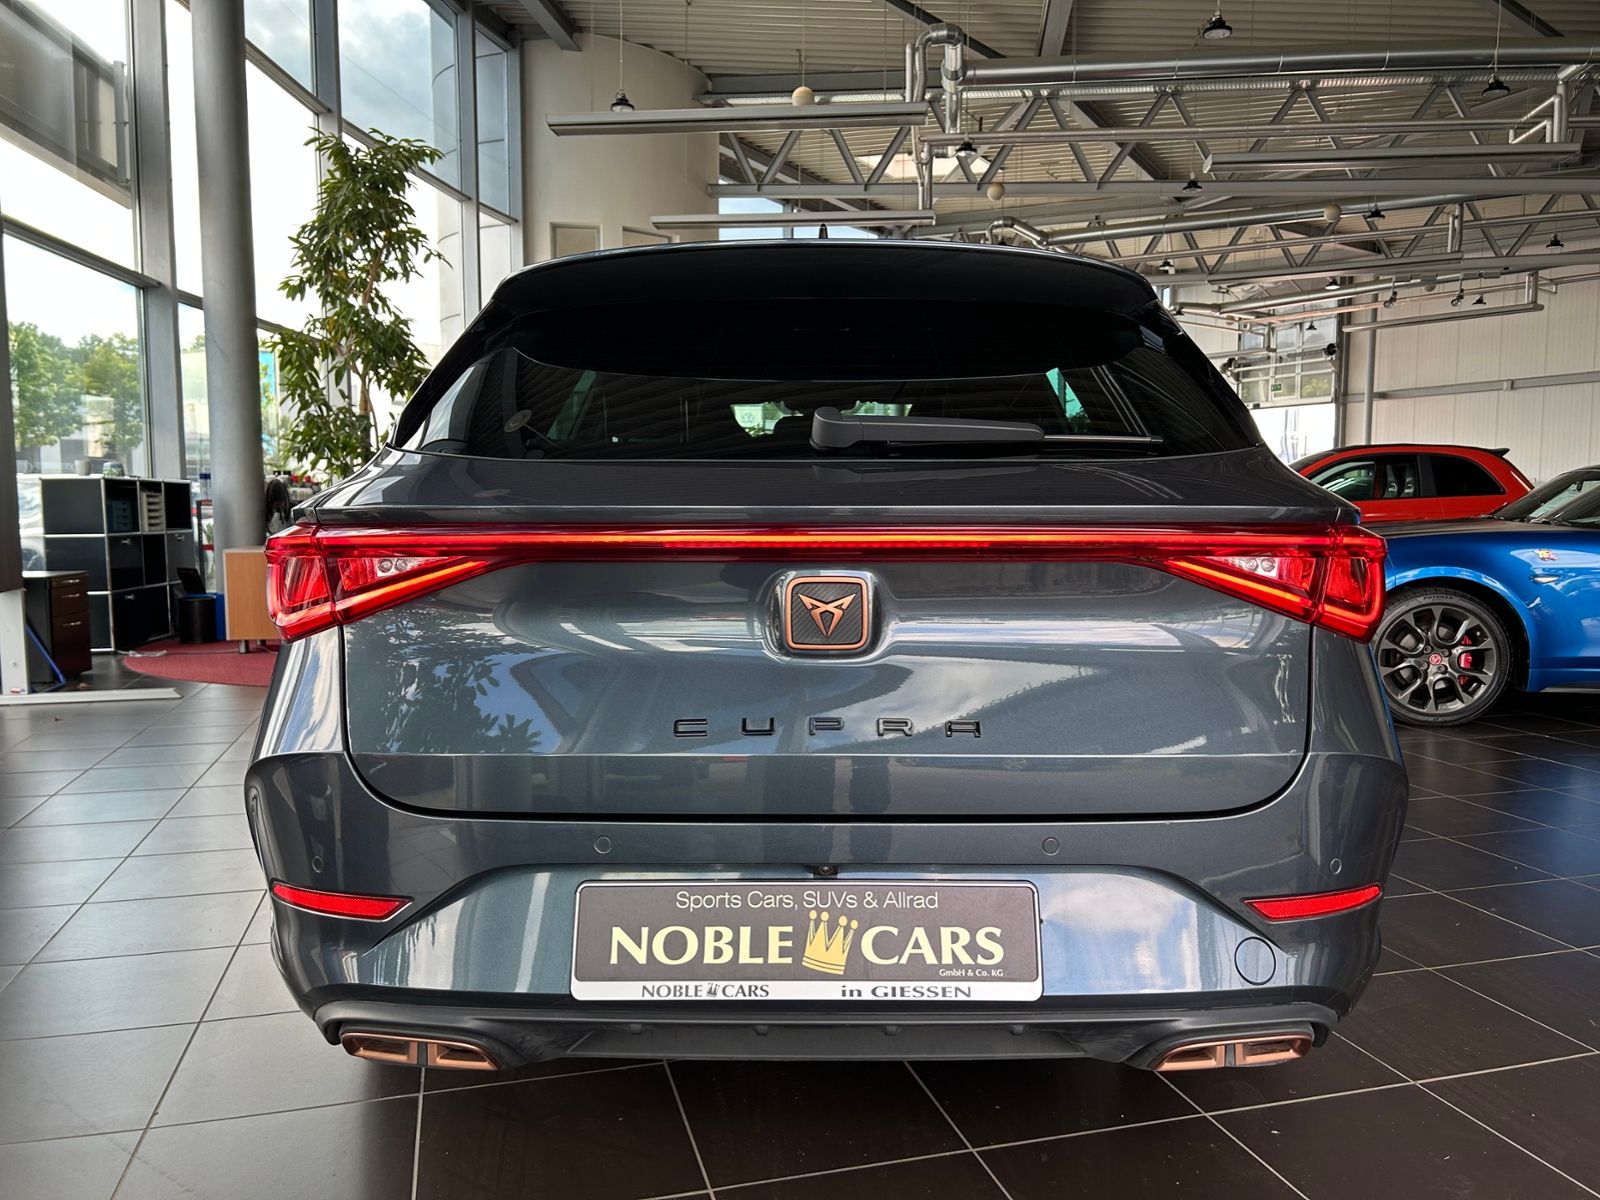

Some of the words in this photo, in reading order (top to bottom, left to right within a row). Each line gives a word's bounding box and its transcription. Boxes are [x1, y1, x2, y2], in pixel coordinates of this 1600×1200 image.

[673, 716, 981, 738] CUPRA
[675, 891, 742, 910] Sports
[747, 891, 798, 911] Cars,
[802, 891, 858, 909] SUVs
[863, 891, 879, 909] &
[882, 891, 939, 909] Allrad
[609, 926, 794, 966] NOBLE
[860, 925, 1005, 966] CARS
[939, 968, 966, 976] GmbH
[641, 984, 701, 998] NOBLE
[721, 984, 770, 998] CARS
[841, 985, 863, 998] in
[870, 986, 972, 998] GIESSEN
